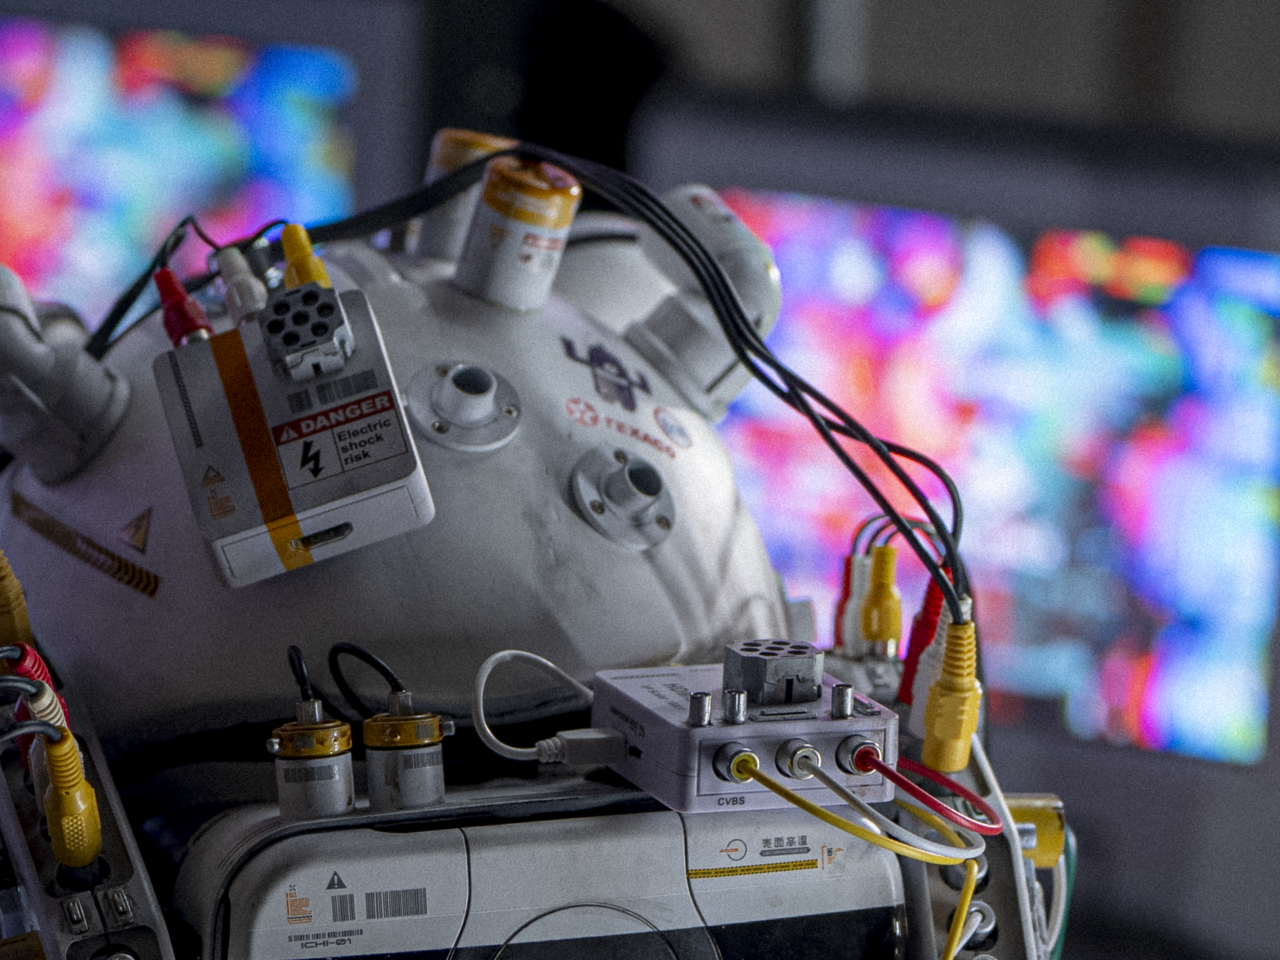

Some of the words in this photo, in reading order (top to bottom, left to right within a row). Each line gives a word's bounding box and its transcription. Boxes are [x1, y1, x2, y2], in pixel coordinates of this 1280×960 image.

[299, 395, 391, 435] DANGER
[337, 418, 392, 442] Electric
[341, 434, 385, 454] shock
[344, 449, 371, 466] risk
[717, 796, 746, 806] CVBS
[300, 937, 352, 949] ICHI-01
